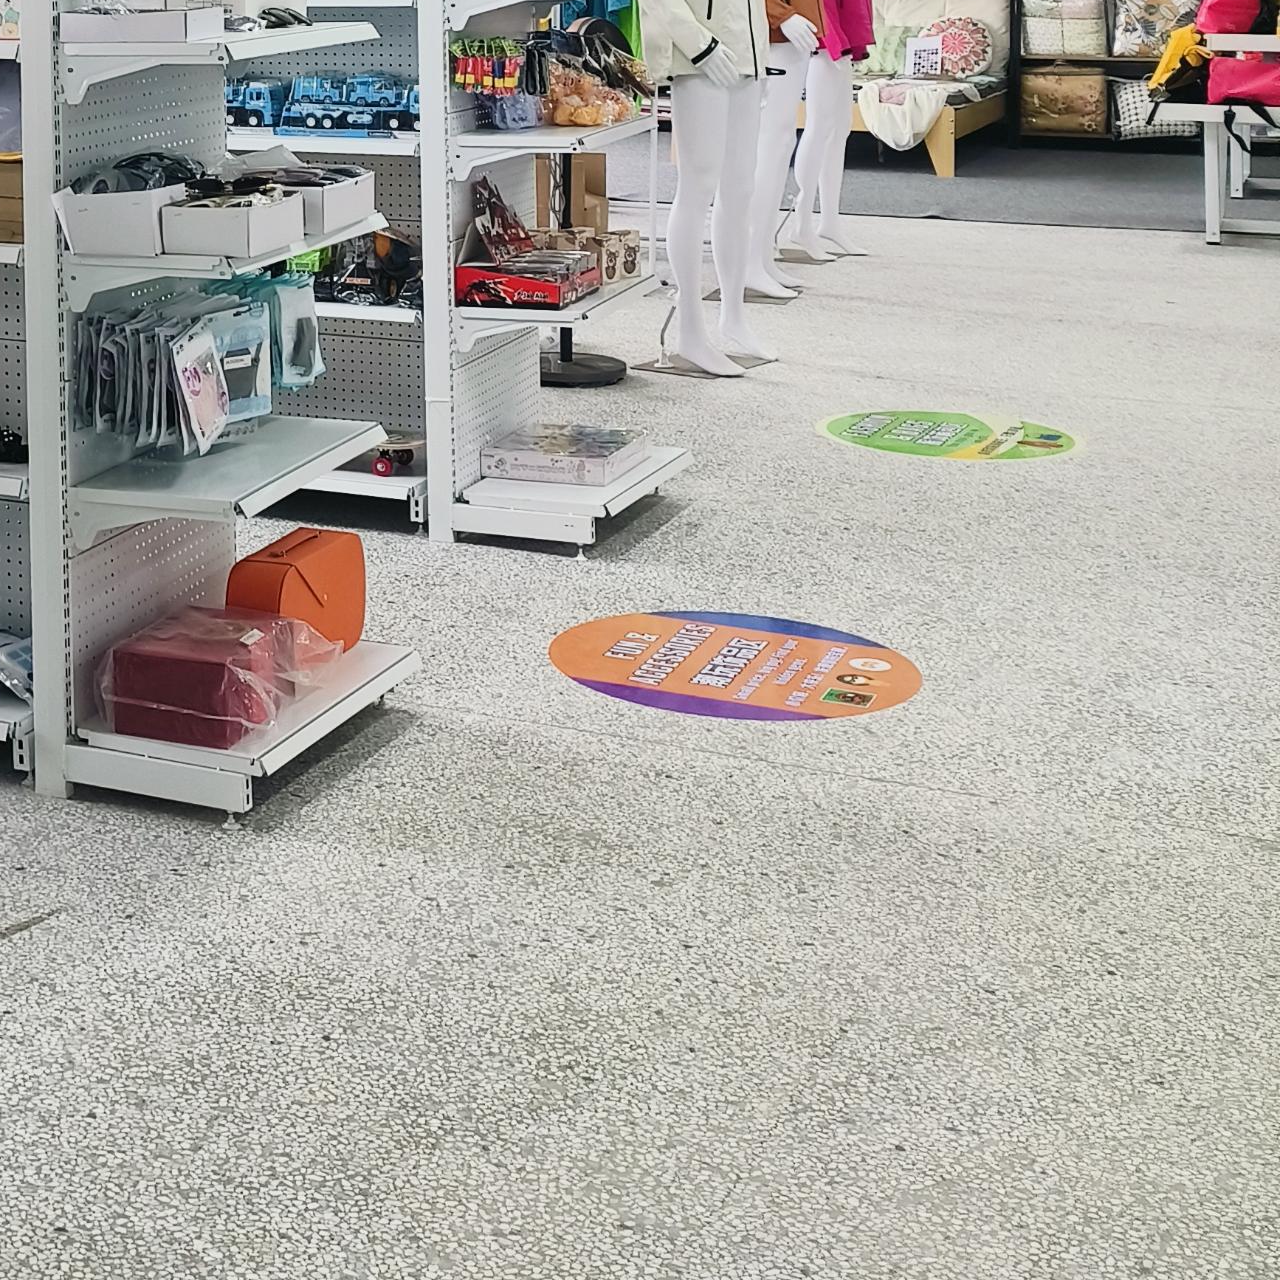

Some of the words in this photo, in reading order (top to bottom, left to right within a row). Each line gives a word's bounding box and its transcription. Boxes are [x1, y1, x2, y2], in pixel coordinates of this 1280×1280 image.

[602, 637, 647, 661] FUN
[641, 631, 662, 645] &
[626, 622, 719, 687] ACCESSORIES
